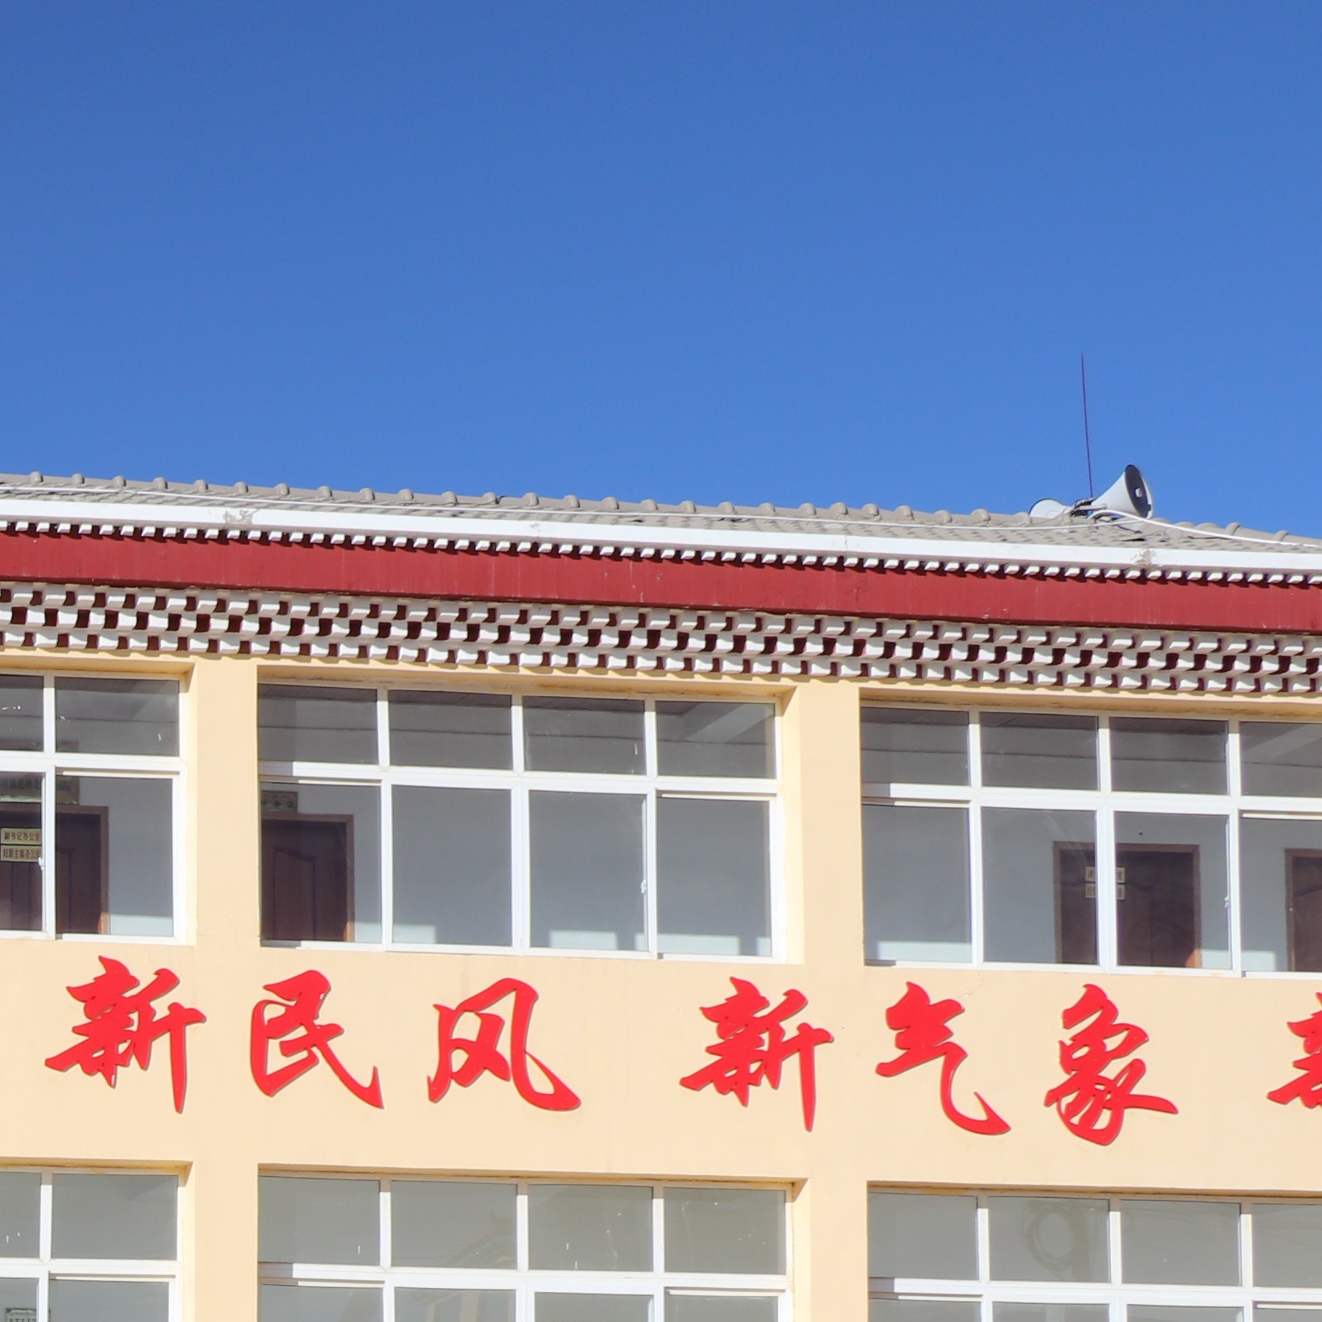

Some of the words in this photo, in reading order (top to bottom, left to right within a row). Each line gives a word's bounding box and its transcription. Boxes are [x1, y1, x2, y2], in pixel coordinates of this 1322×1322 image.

[44, 955, 581, 1113] 新民风
[679, 976, 1178, 1146] 新气象
